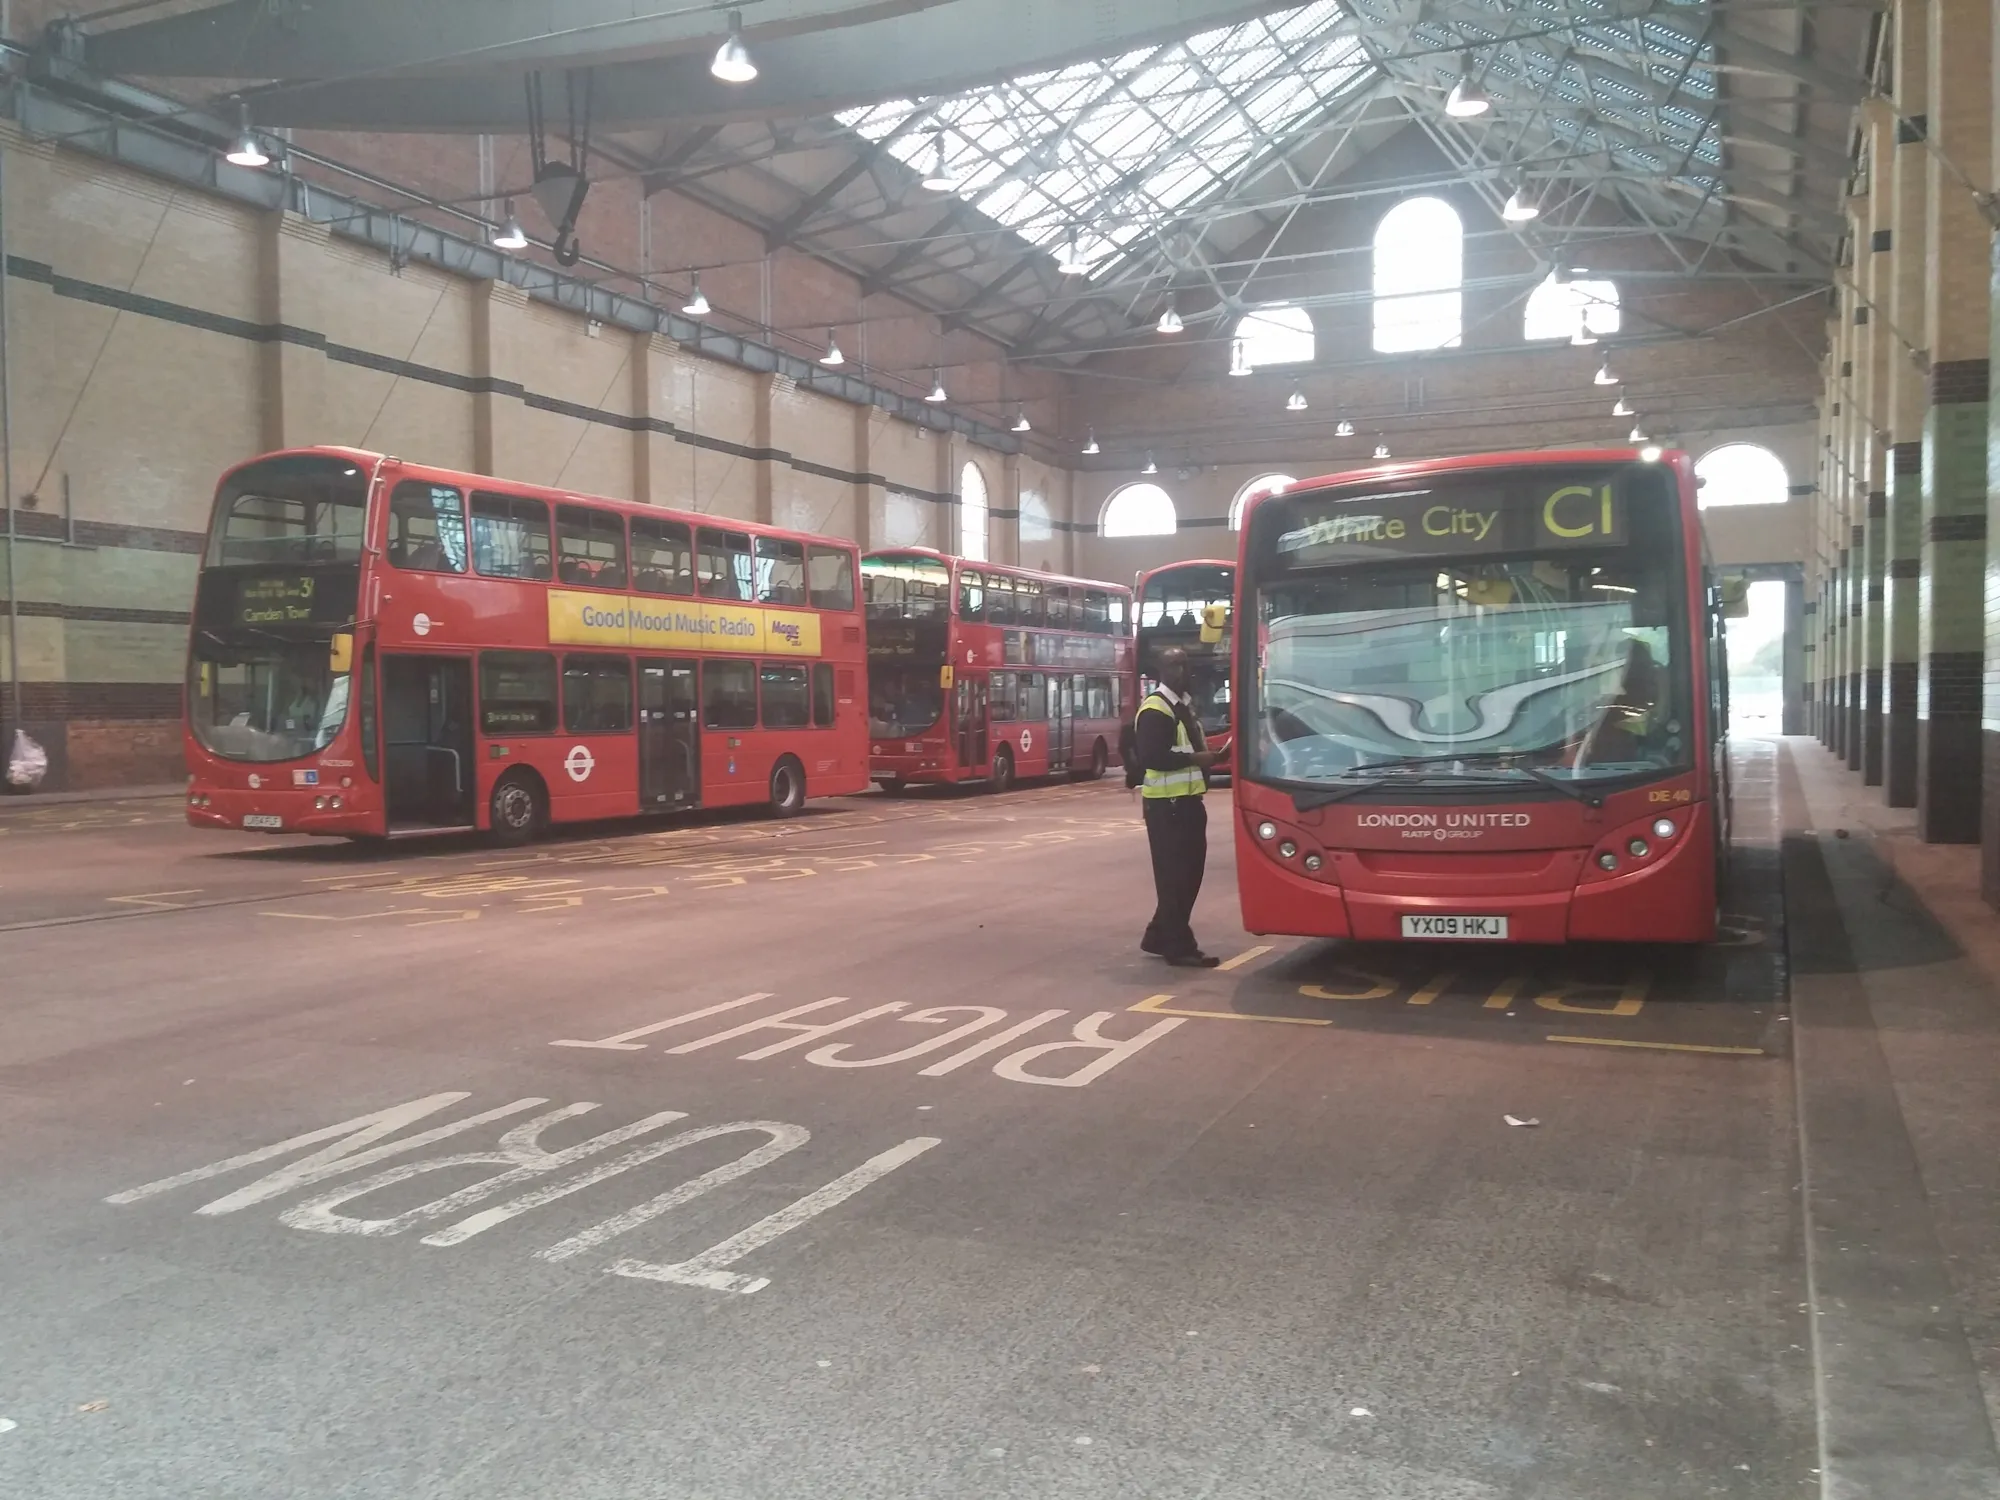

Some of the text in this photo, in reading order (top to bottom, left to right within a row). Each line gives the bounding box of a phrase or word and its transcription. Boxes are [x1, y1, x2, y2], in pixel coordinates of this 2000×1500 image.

[1543, 484, 1612, 538] C1
[1303, 505, 1498, 544] White City
[243, 607, 284, 622] Camden
[582, 605, 756, 637] Good Mood Music Radio
[771, 619, 800, 642] Magic
[1649, 790, 1670, 801] DE
[1357, 813, 1531, 827] LONDON UNITED
[1401, 829, 1484, 838] RATP GROUP
[1410, 917, 1500, 935] YX09 HKJ
[550, 993, 1188, 1088] RIGHT
[103, 1090, 942, 1296] TURN
